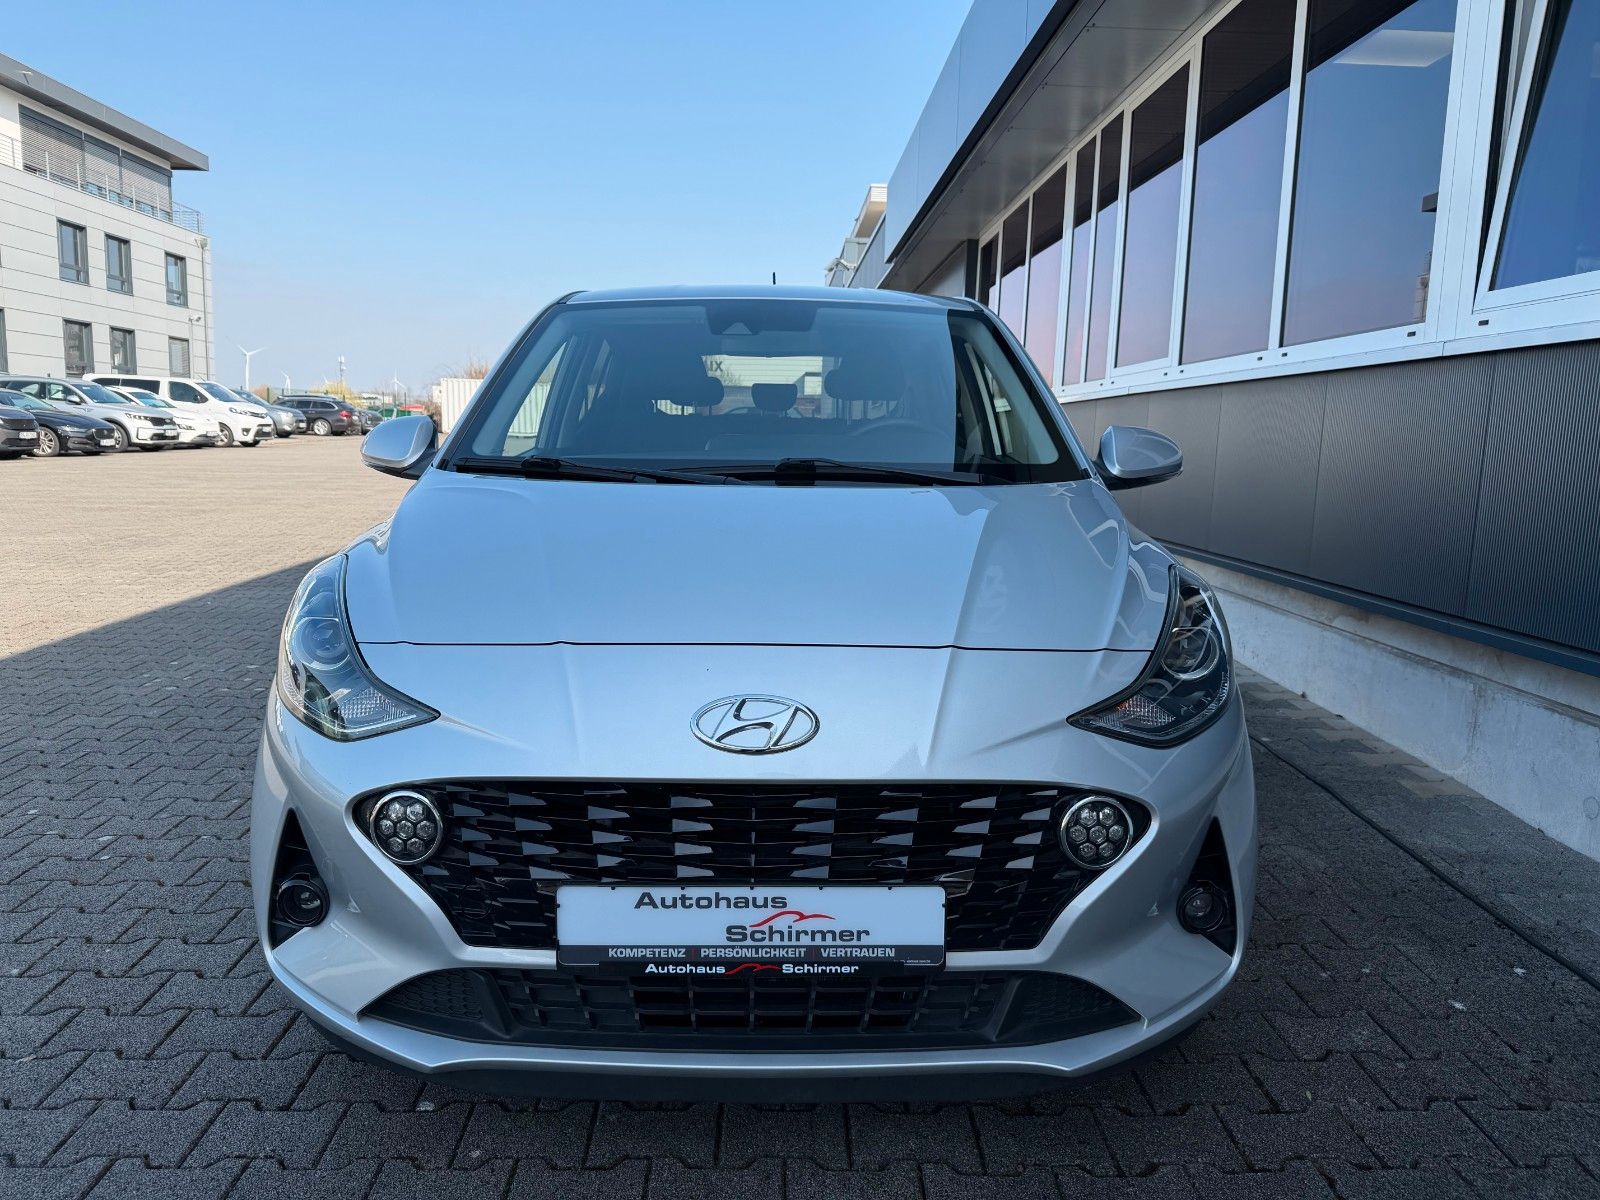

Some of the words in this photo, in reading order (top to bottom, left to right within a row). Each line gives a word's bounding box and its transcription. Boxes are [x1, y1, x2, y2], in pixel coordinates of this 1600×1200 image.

[634, 891, 788, 911] Autohaus
[725, 923, 871, 943] Schirmer
[608, 947, 686, 958] KOMPETENZ
[700, 945, 807, 958] PERSÖNLICHKEIT
[820, 947, 896, 958] VERTRAUEN
[645, 963, 726, 974] Autohaus
[782, 963, 859, 974] Schirmer
